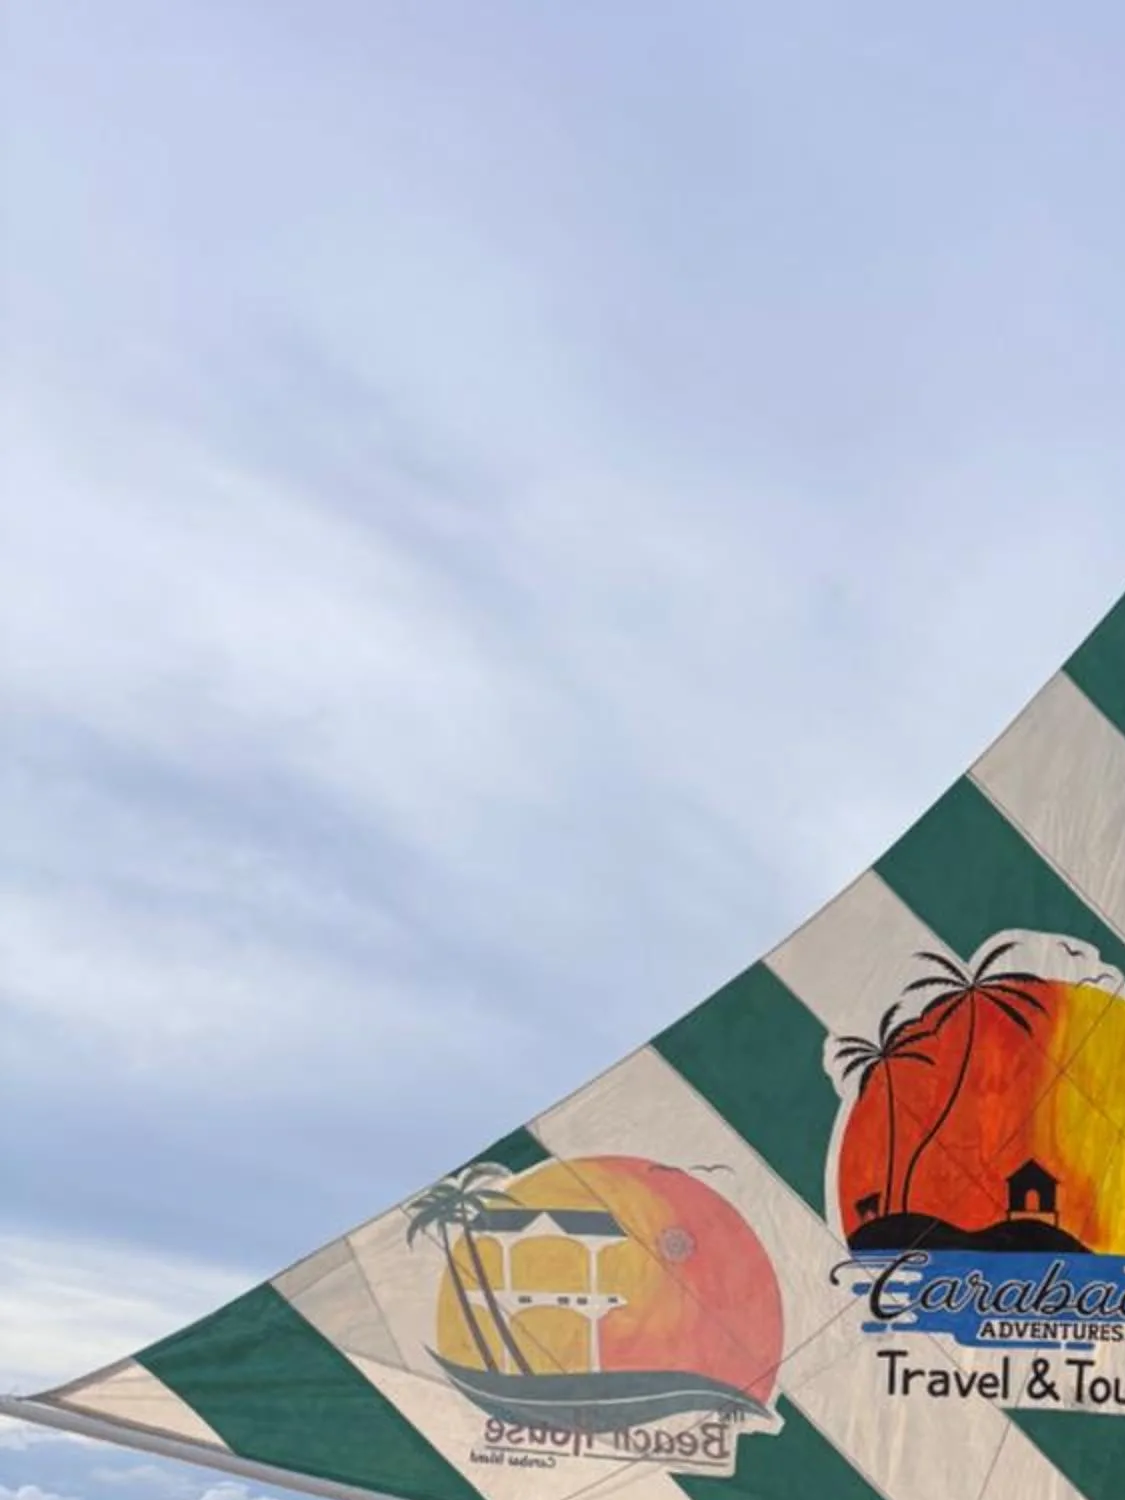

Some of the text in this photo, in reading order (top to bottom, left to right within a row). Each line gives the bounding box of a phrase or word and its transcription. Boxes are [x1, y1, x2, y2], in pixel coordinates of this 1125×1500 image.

[980, 1321, 1124, 1342] ADVENTURES
[877, 1350, 1009, 1399] Travel
[1027, 1357, 1061, 1403] &
